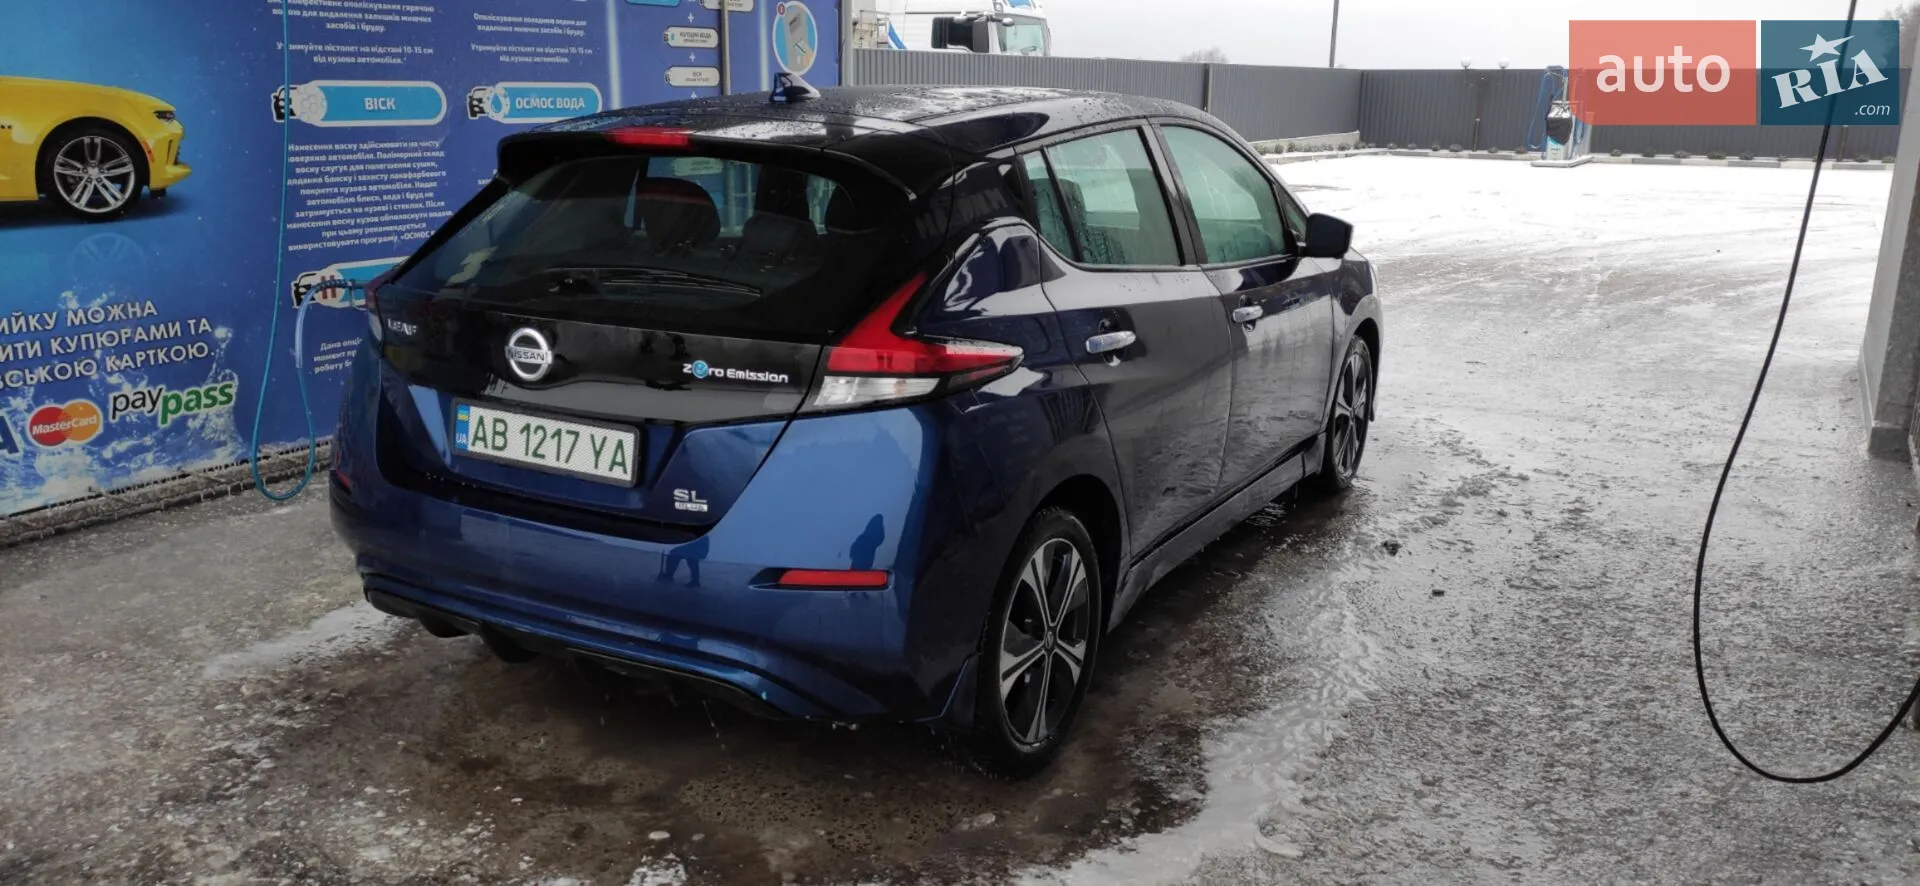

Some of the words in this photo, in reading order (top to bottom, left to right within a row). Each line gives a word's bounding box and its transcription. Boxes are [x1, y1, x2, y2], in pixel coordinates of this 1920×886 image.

[272, 8, 301, 16] воою
[319, 11, 362, 19] видалення
[326, 22, 356, 30] засобів
[325, 43, 358, 52] пістолет
[371, 45, 402, 53] відстані
[328, 56, 355, 64] кузова
[364, 97, 396, 110] ВІСК
[515, 97, 554, 109] ОСМОС
[556, 97, 586, 111] ВОДА
[288, 143, 333, 152] Нанесення
[334, 143, 357, 151] воску
[423, 150, 445, 158] склад
[348, 164, 363, 172] для
[324, 174, 353, 184] блиску
[358, 173, 388, 182] захисту
[300, 187, 338, 196] покриття
[340, 185, 367, 195] кузова
[406, 191, 424, 199] бруд
[426, 200, 445, 208] Після
[287, 219, 331, 229] нанесення
[332, 218, 355, 226] воску
[356, 216, 379, 224] кузов
[322, 230, 337, 238] при
[338, 228, 363, 236] цьому
[67, 300, 157, 327] МОЖНА
[387, 318, 417, 336] LEAF
[51, 322, 182, 356] КУПЮРАМИ
[188, 318, 212, 335] ТА
[320, 341, 341, 351] Дана
[314, 350, 345, 362] момент
[507, 349, 545, 361] NISSAN
[0, 359, 97, 391] СЬКОЮ
[105, 342, 215, 373] КАРТКОЮ.
[314, 362, 343, 374] роботу
[726, 368, 788, 383] Emission
[111, 383, 234, 426] paypass
[31, 415, 97, 435] MasterCard
[455, 432, 468, 445] UA
[470, 415, 508, 451] AB
[519, 423, 580, 464] 1217
[589, 432, 628, 475] YA
[673, 488, 708, 503] SL
